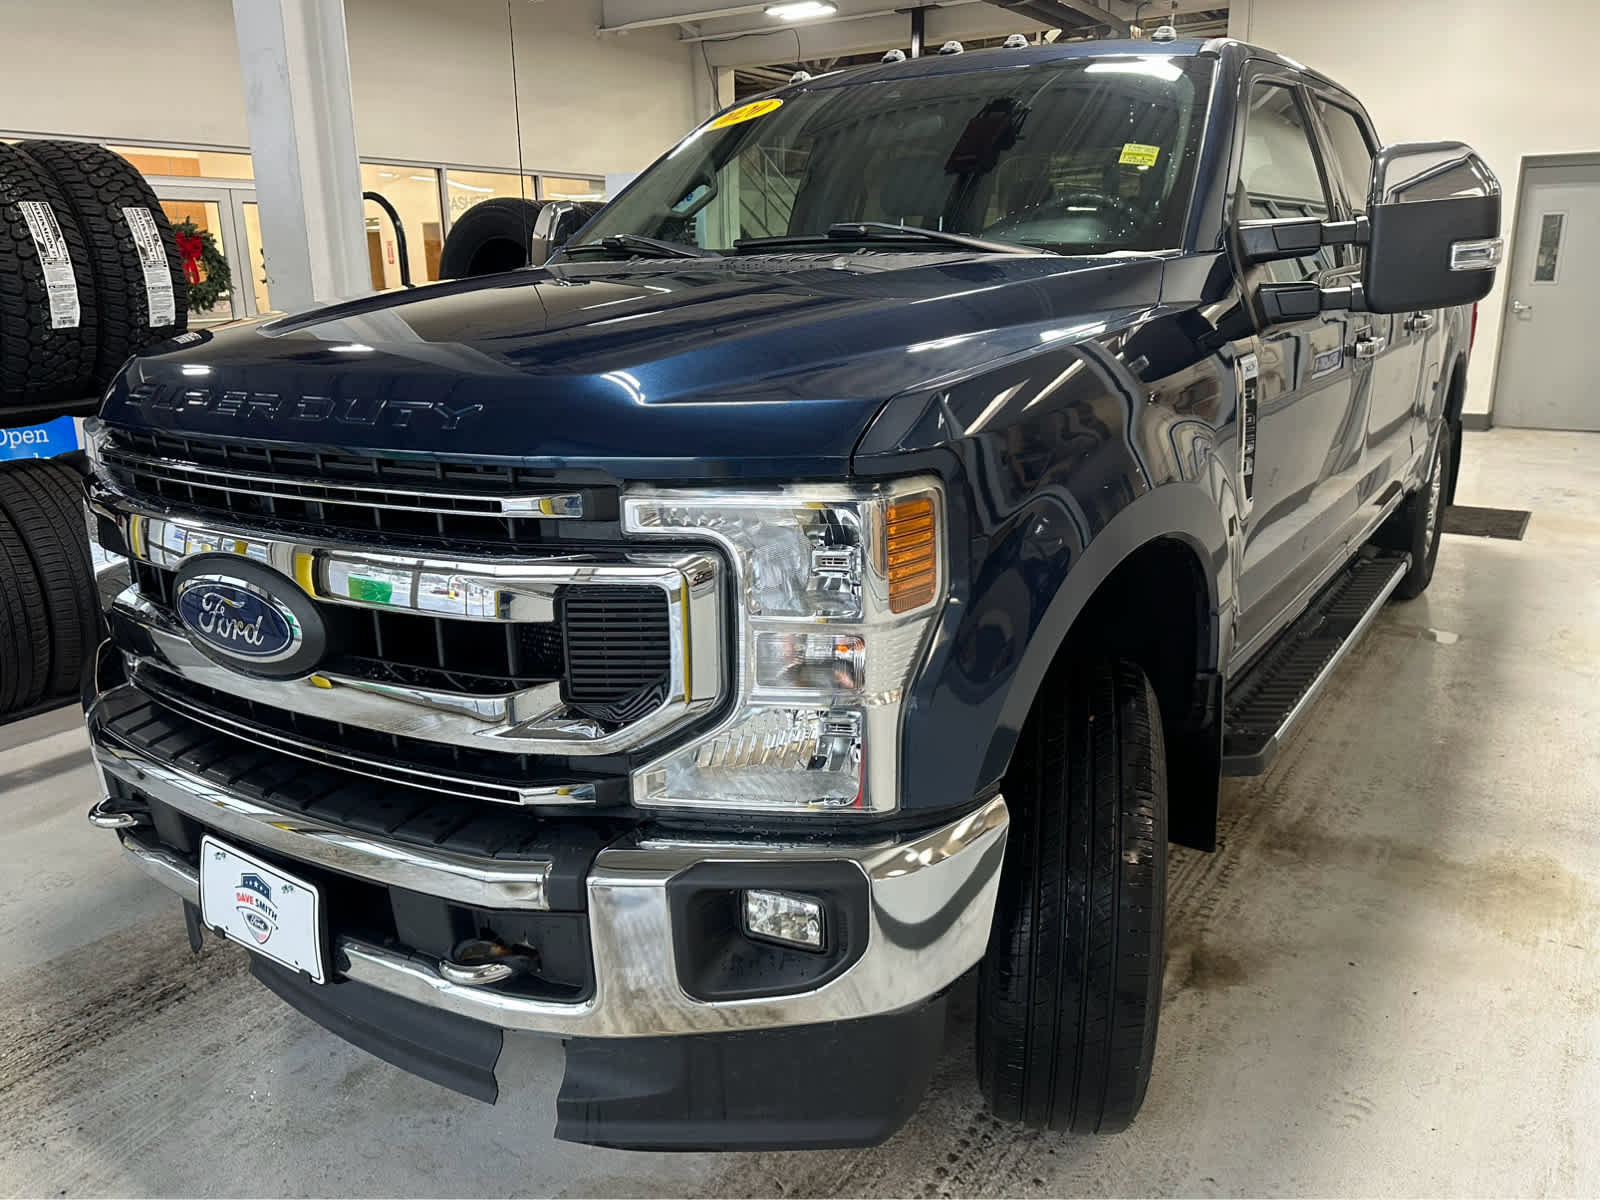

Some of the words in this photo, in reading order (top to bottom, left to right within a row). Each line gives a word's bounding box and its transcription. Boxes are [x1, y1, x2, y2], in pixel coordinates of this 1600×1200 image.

[123, 384, 284, 421] SUPER
[289, 395, 484, 431] DUTY
[0, 429, 50, 449] Open
[198, 592, 265, 646] Ford
[236, 892, 255, 905] DAVE
[255, 898, 278, 921] SMITH
